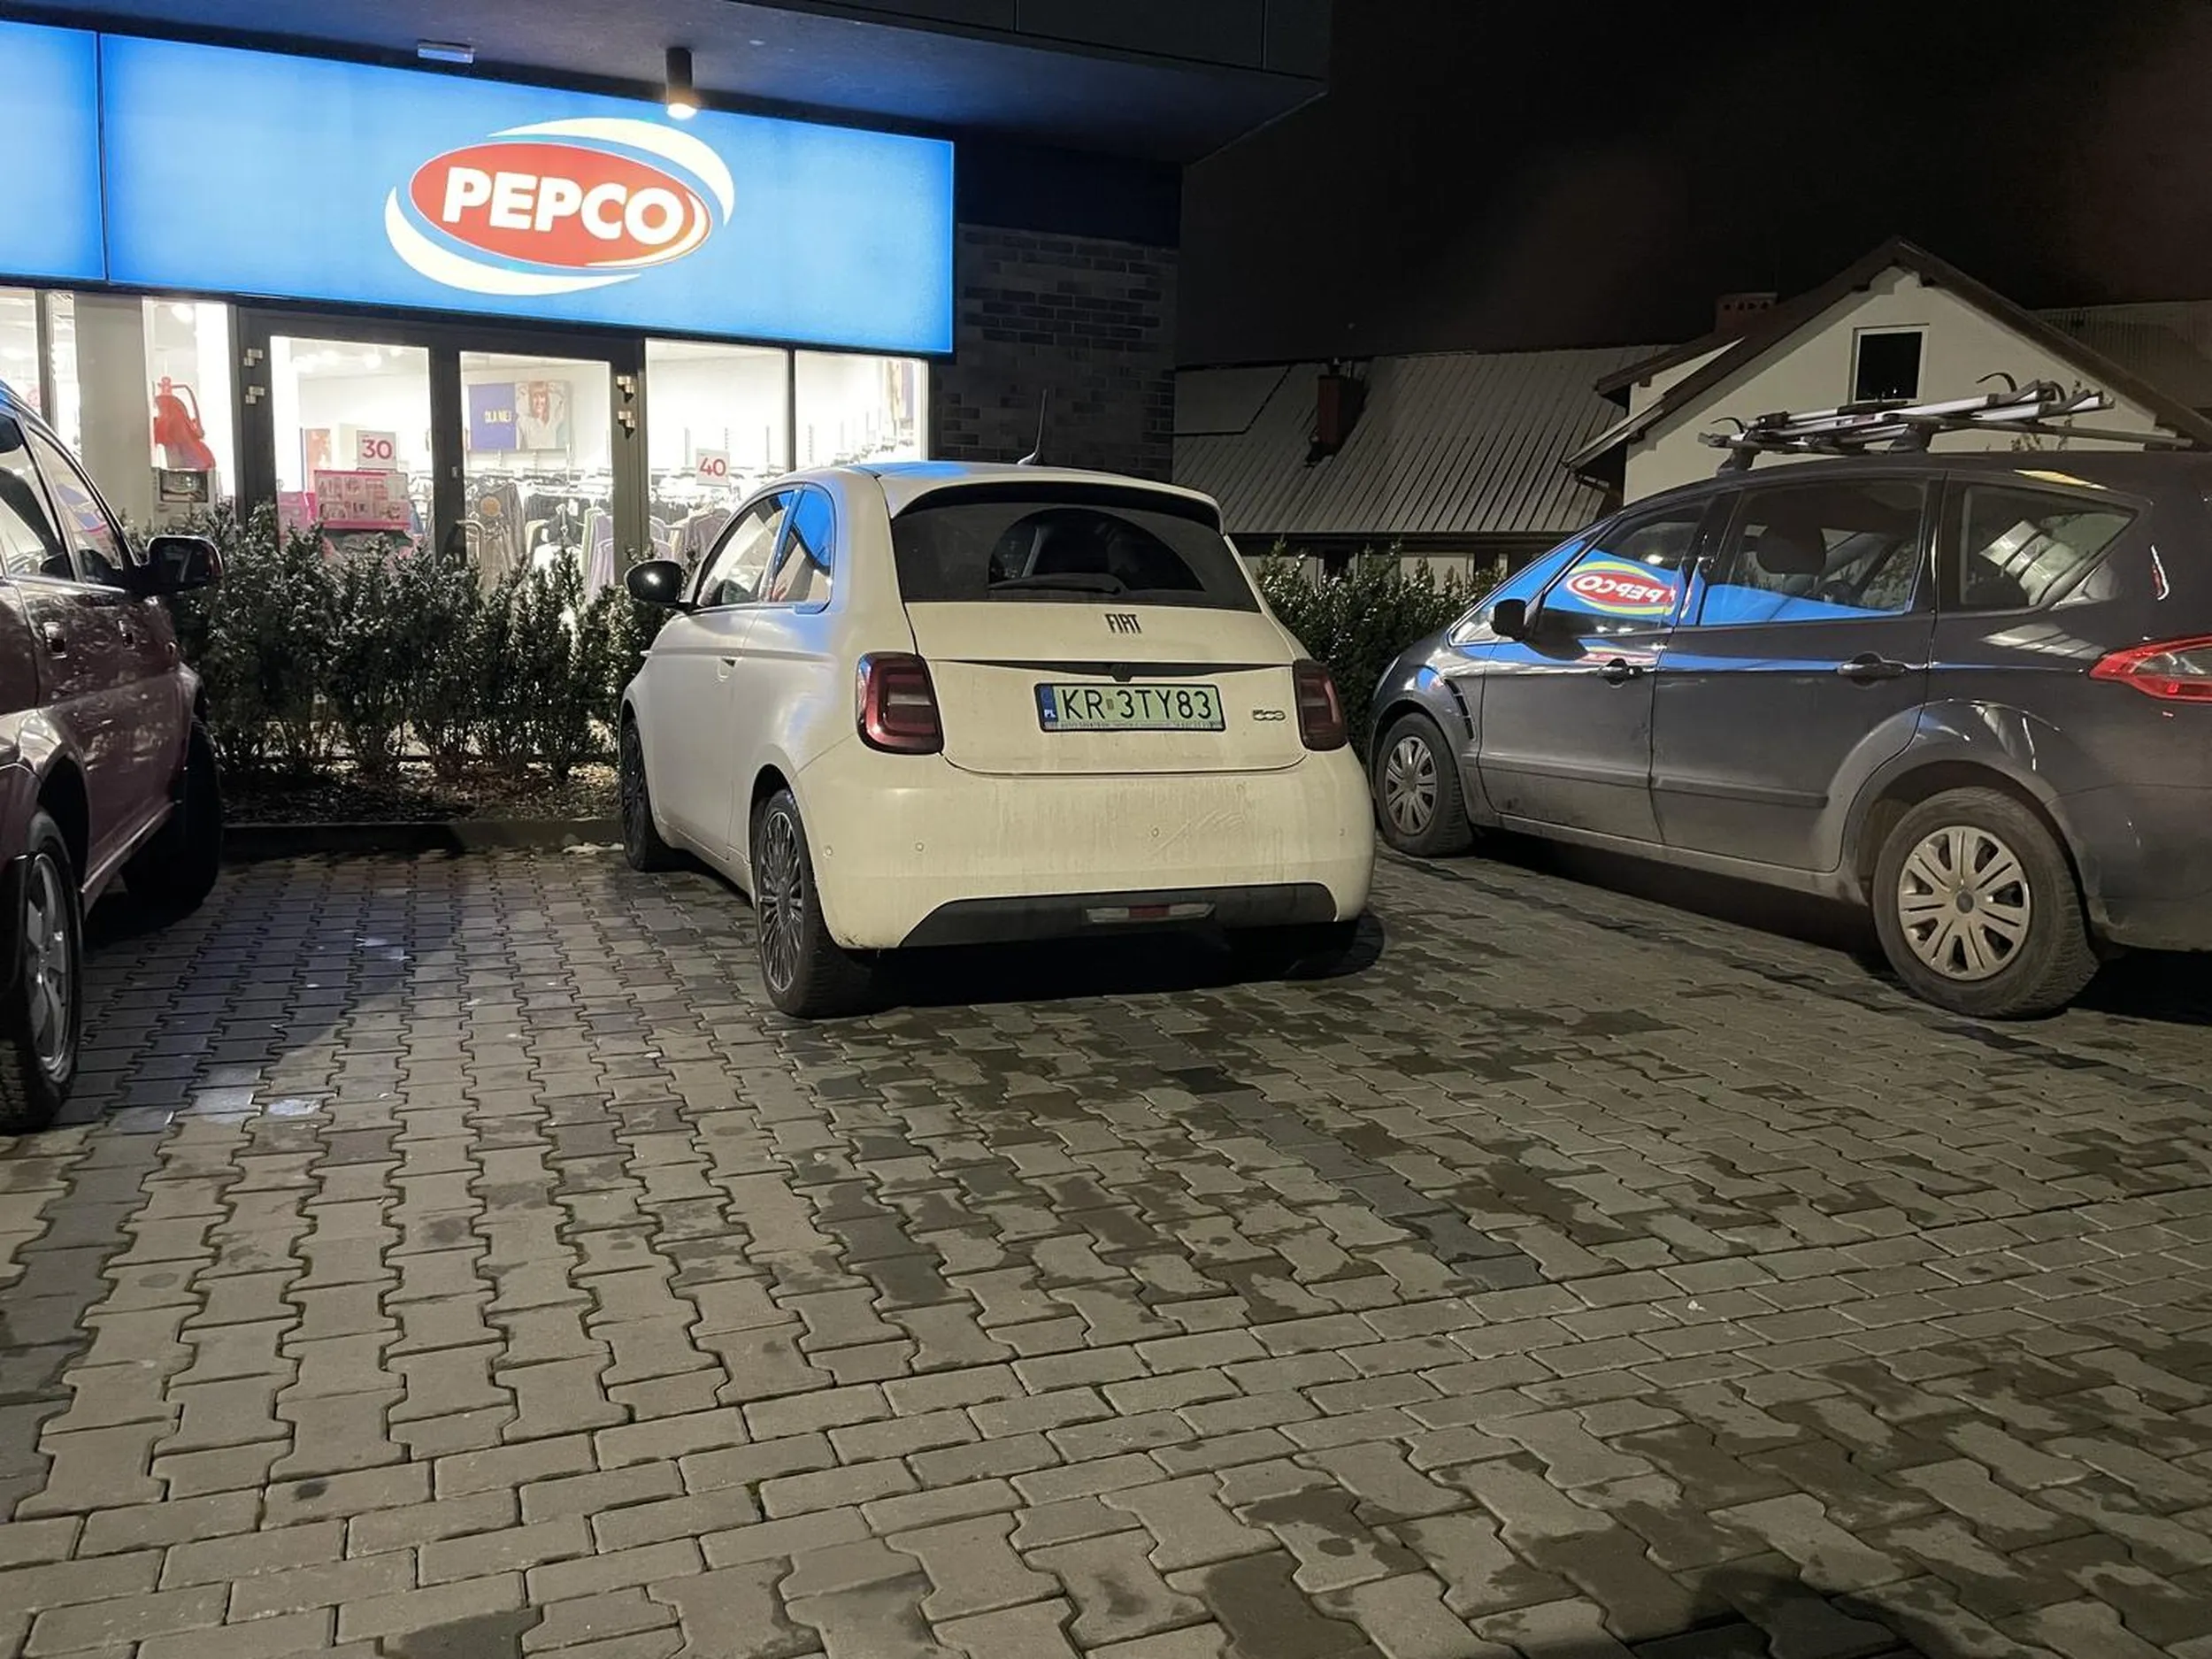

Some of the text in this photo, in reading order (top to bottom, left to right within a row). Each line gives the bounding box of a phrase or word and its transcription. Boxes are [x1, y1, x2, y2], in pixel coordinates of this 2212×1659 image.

[442, 166, 684, 245] PEPCO
[361, 438, 393, 459] 30
[699, 457, 726, 477] 40
[1105, 613, 1142, 634] FIAT
[1044, 709, 1056, 718] PL
[1062, 689, 1211, 719] KR 3TY83
